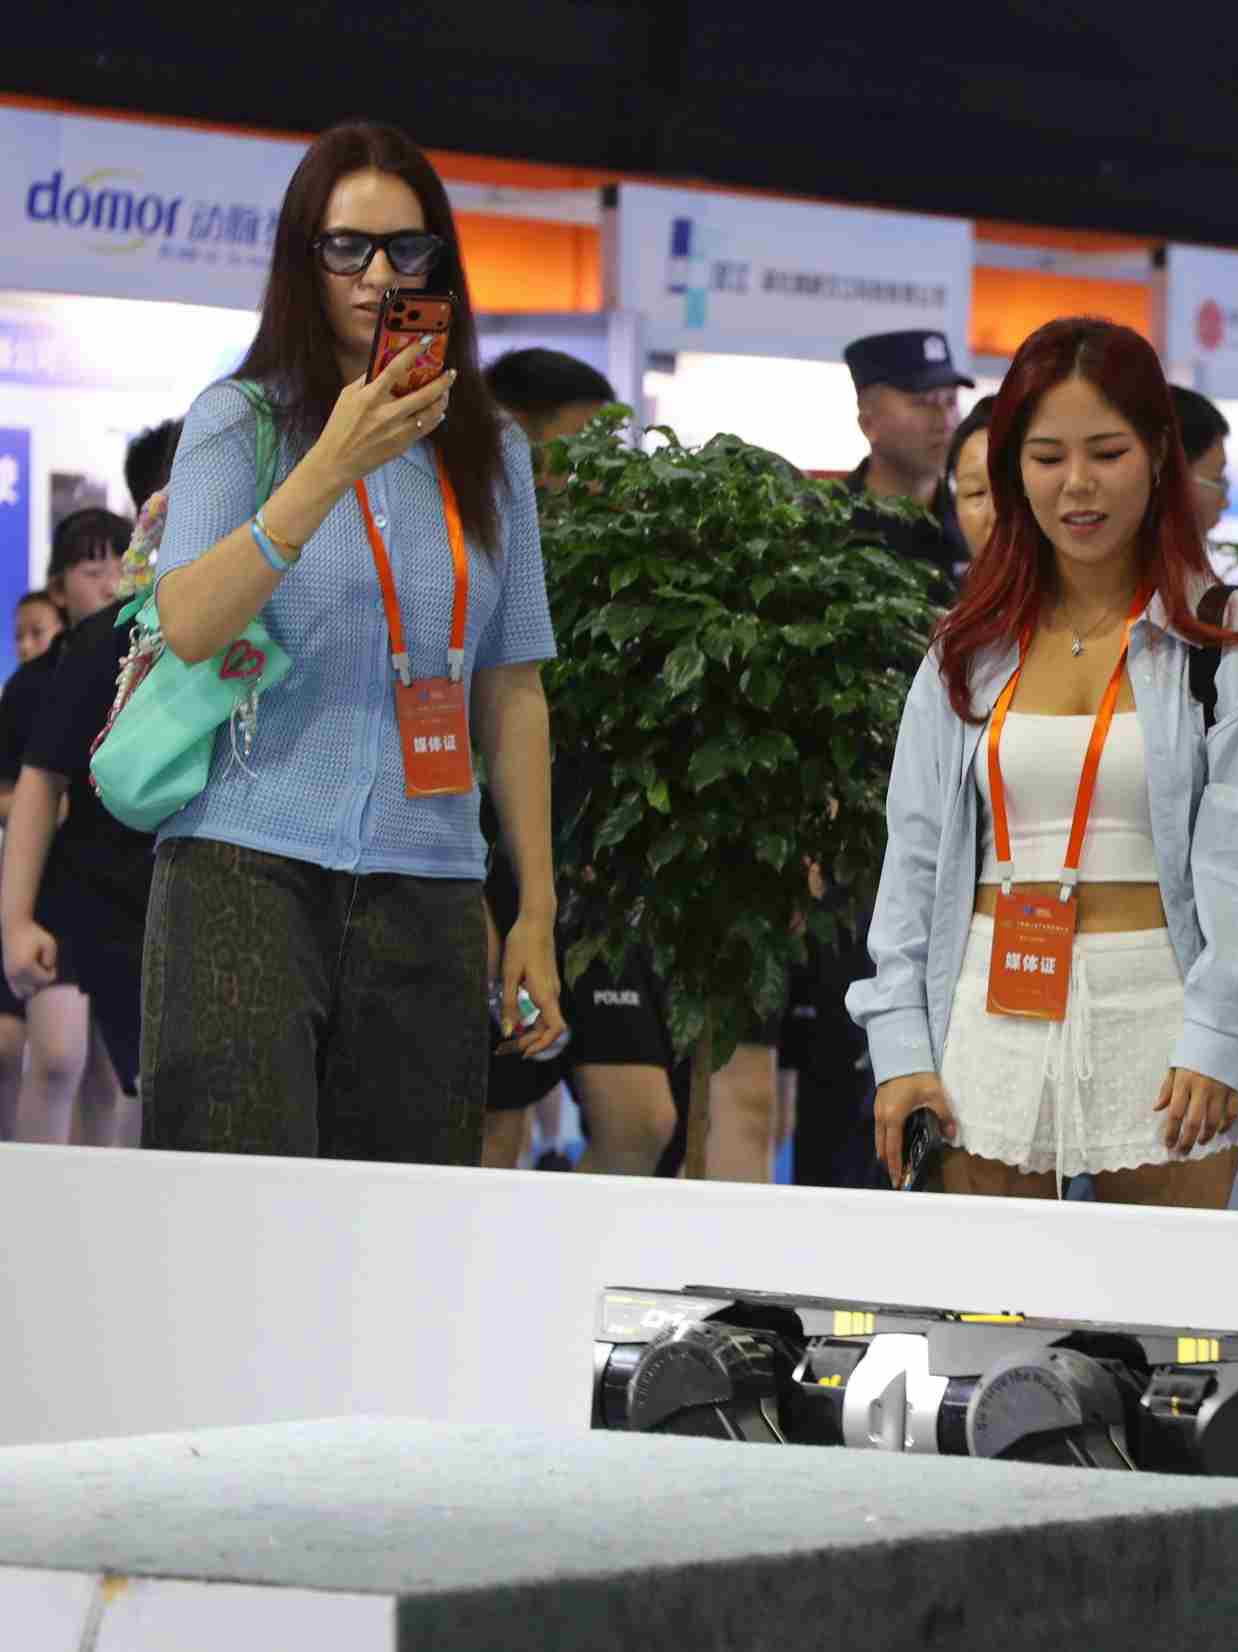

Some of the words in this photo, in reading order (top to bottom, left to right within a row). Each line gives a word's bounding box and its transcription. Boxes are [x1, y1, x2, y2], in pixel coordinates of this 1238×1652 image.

[26, 169, 183, 237] domor
[413, 735, 457, 753] 媒体证
[1005, 951, 1057, 975] 媒体证
